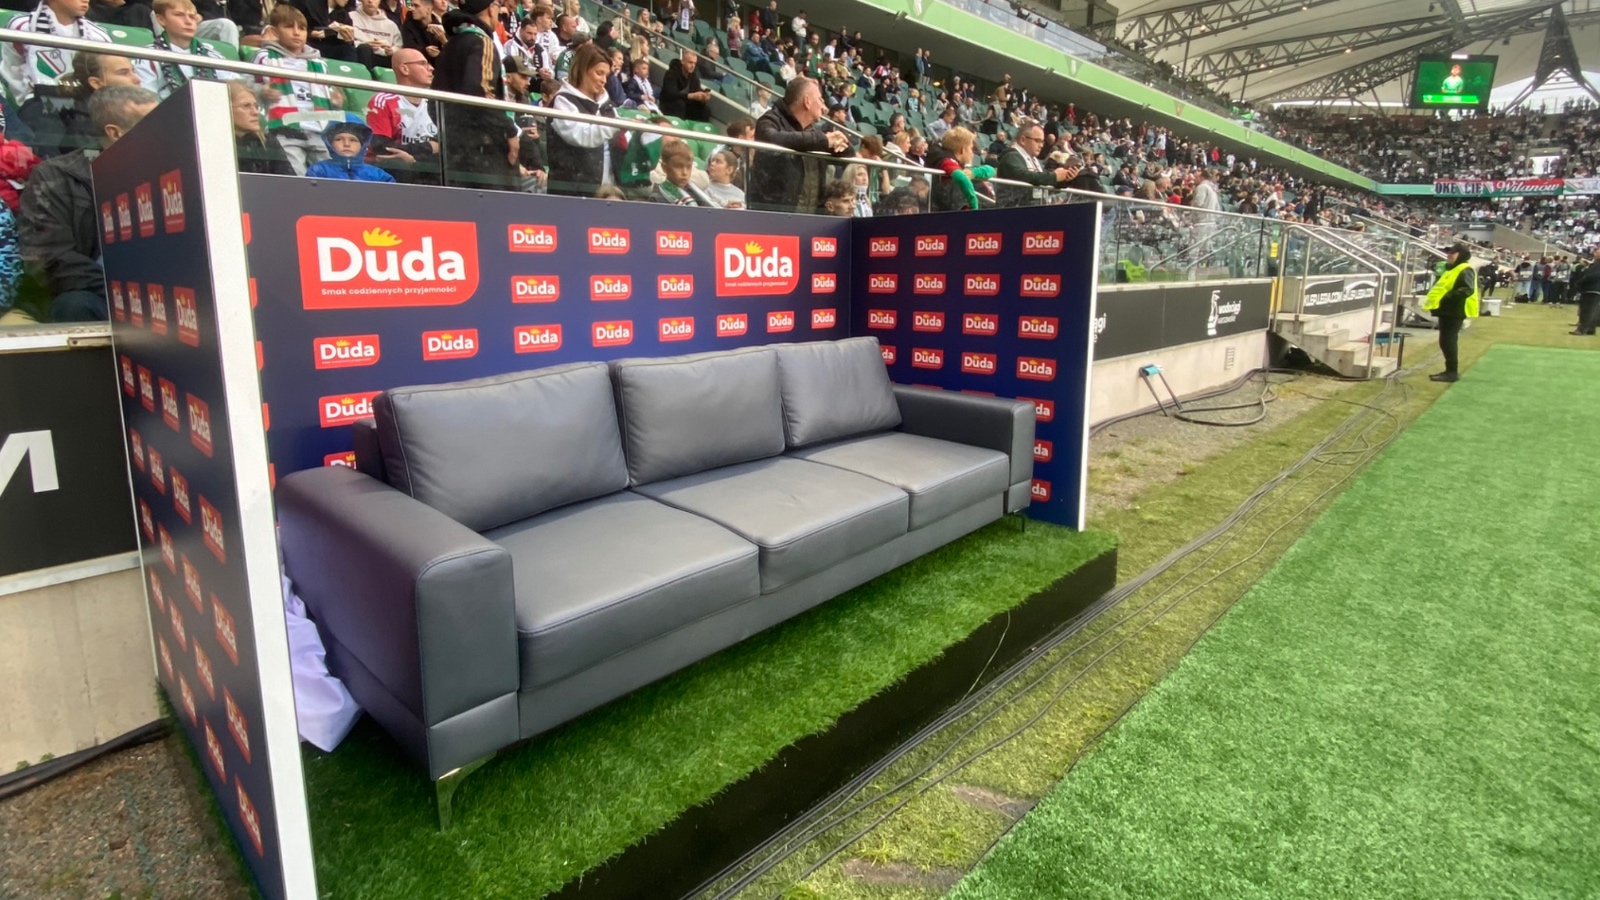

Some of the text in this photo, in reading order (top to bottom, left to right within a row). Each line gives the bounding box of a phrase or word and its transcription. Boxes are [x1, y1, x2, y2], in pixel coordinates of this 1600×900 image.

[1497, 180, 1560, 193] Wilanów
[163, 182, 184, 217] Duda
[512, 229, 554, 245] Duda
[591, 232, 627, 247] Duda
[659, 235, 690, 249] Duda
[968, 237, 999, 250] Duda
[1025, 235, 1060, 249] Duda
[813, 241, 835, 252] Duda
[871, 240, 897, 252] Duda
[917, 239, 945, 251] Duda
[316, 236, 466, 282] Duda
[724, 246, 793, 278] Duda
[515, 280, 556, 296] Duda
[593, 279, 629, 294] Duda
[660, 279, 691, 292] Duda
[813, 277, 835, 288] Duda
[870, 277, 896, 289] Duda
[916, 277, 943, 289] Duda
[966, 277, 997, 290] Duda
[1023, 278, 1057, 292] Duda
[349, 286, 401, 295] codziennych
[404, 285, 457, 295] przyjemności
[176, 298, 198, 331] Duda
[769, 315, 793, 327] Duda
[813, 312, 835, 324] Duda
[870, 313, 895, 325] Duda
[915, 315, 942, 327] Duda
[662, 321, 692, 335] Duda
[719, 318, 746, 331] Duda
[965, 317, 995, 330] Duda
[1021, 320, 1055, 334] Duda
[518, 329, 559, 346] Duda
[595, 325, 630, 340] Duda
[427, 334, 474, 352] Duda
[319, 339, 376, 361] Duda
[881, 348, 894, 360] da
[914, 351, 941, 364] Duda
[964, 356, 994, 370] Duda
[1019, 361, 1053, 375] Duda
[1035, 403, 1050, 416] da
[189, 404, 212, 443] Duda
[1034, 443, 1049, 457] da
[1032, 483, 1047, 496] da
